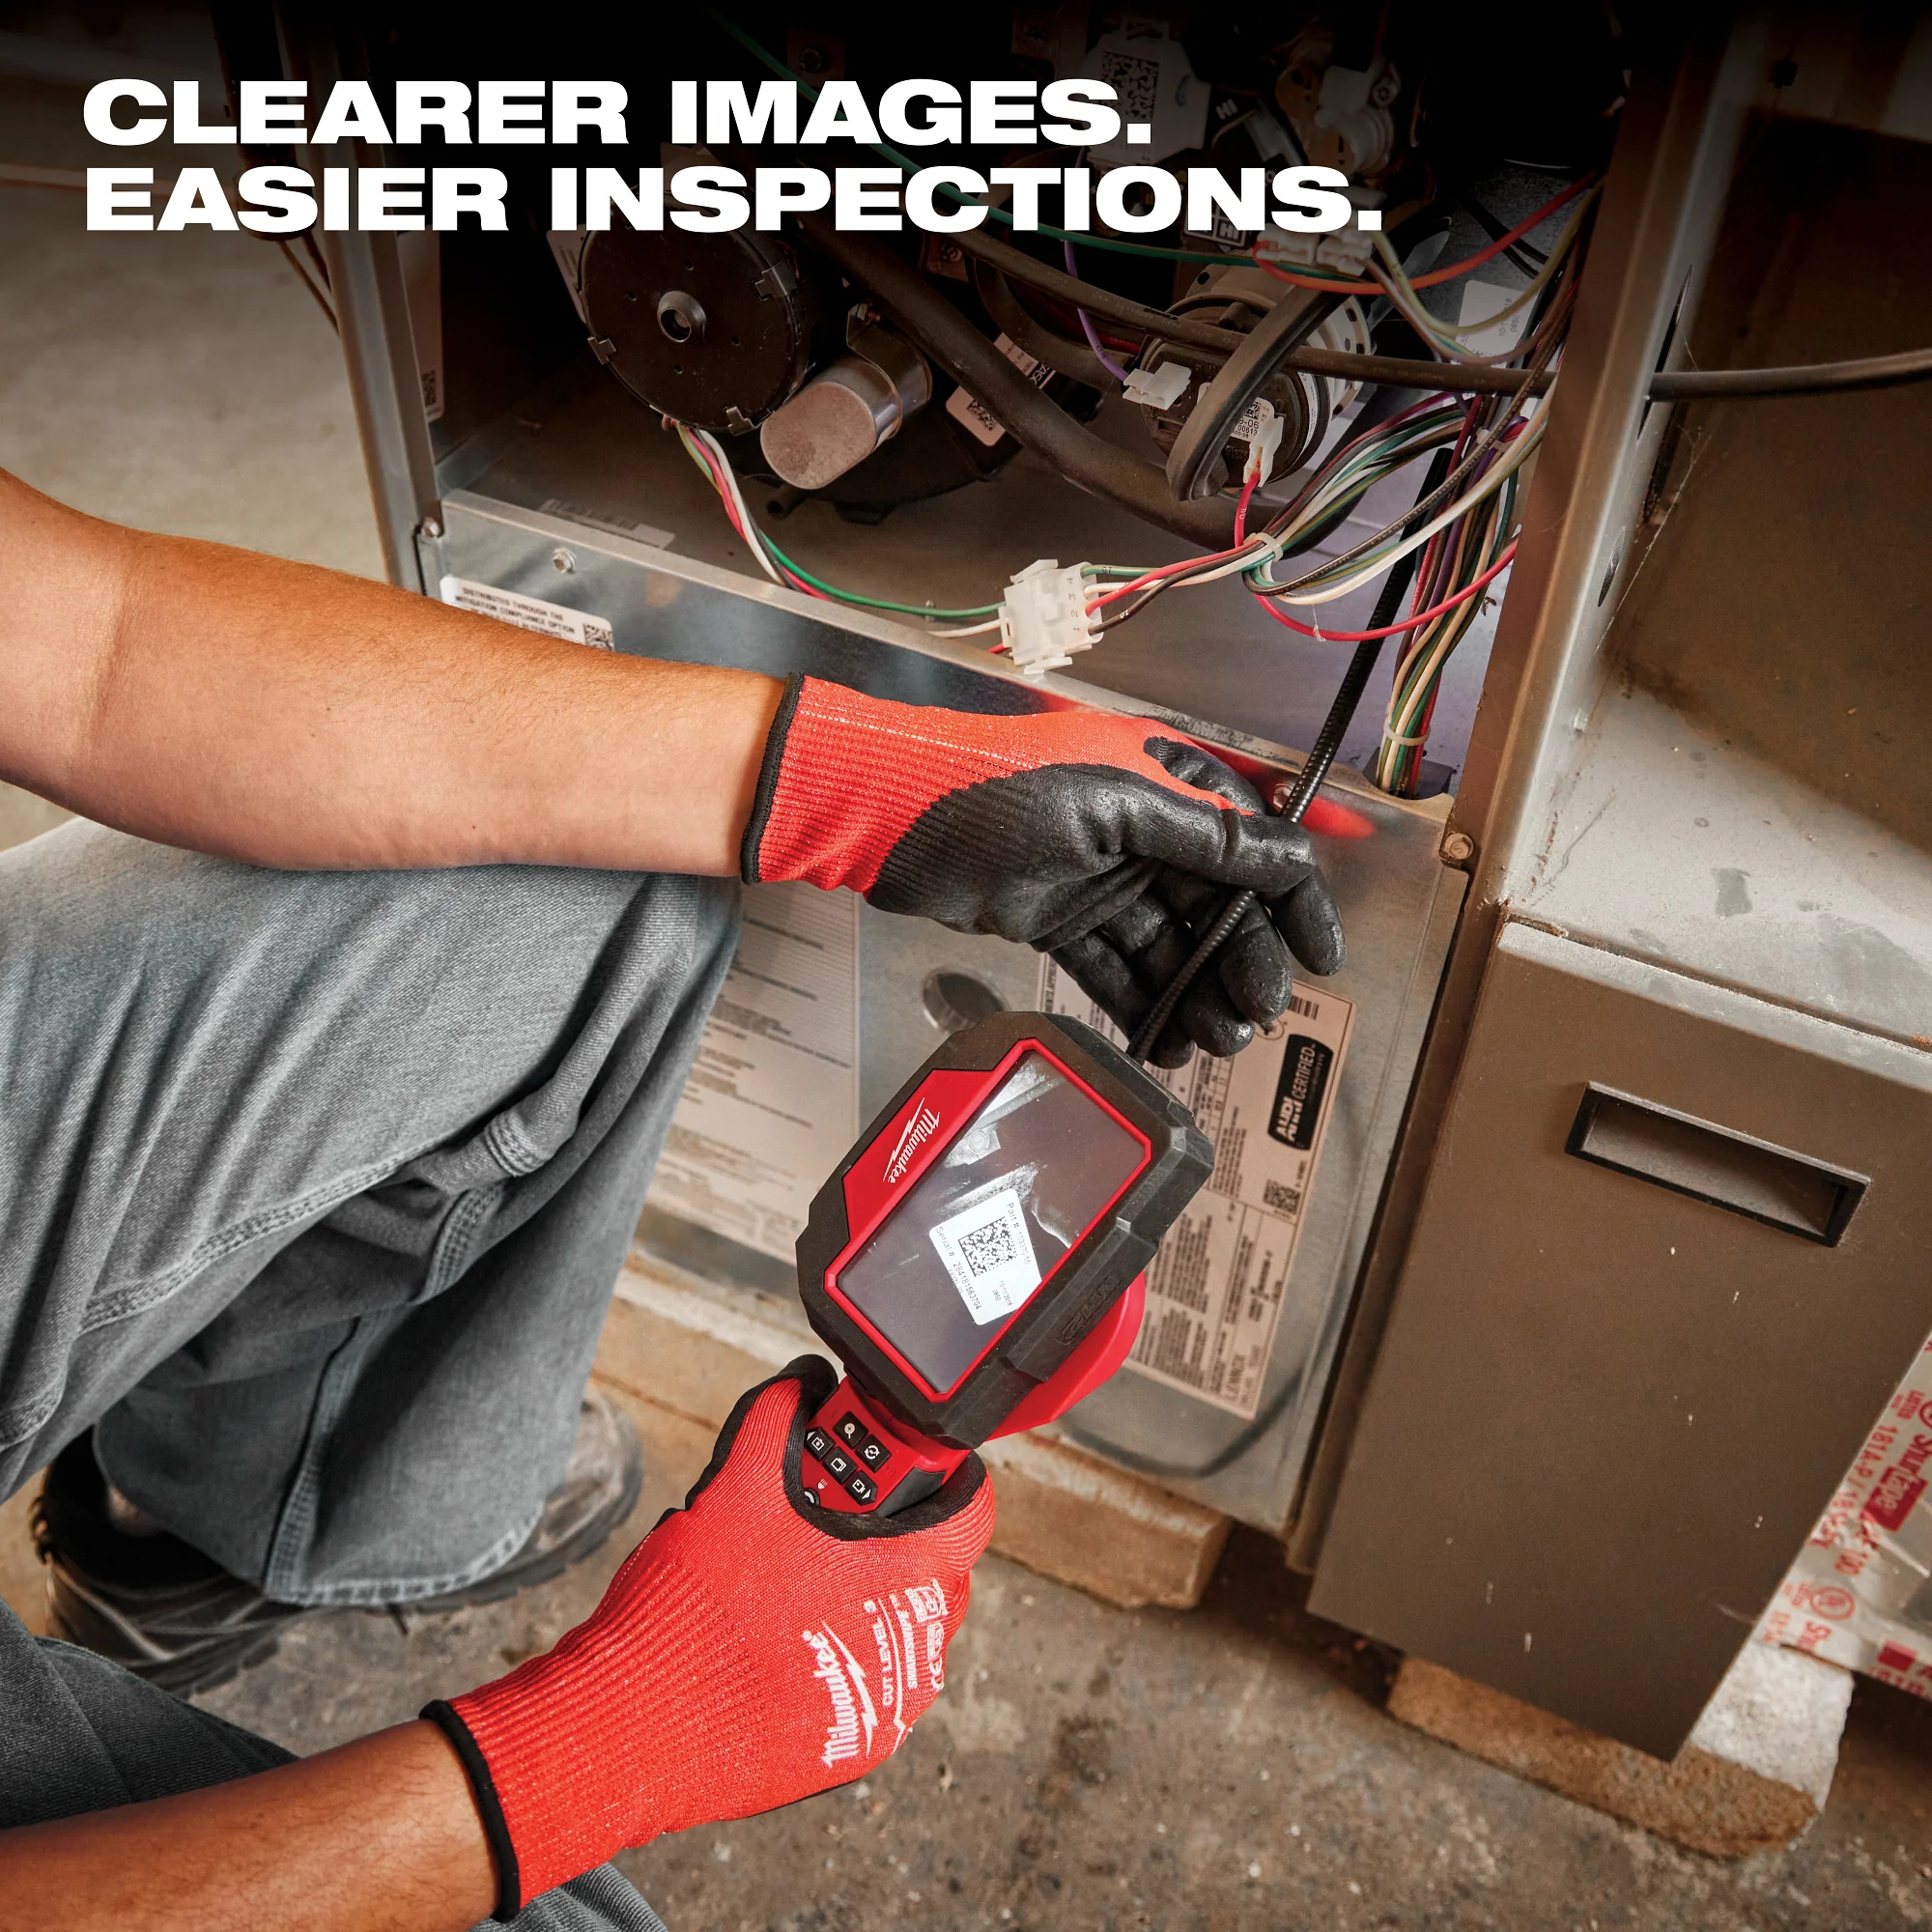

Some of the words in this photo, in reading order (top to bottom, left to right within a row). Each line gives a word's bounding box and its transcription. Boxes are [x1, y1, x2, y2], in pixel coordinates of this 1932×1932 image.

[1290, 1046, 1315, 1099] CERTIFIED
[885, 1108, 940, 1183] Milwaukee
[1008, 1202, 1017, 1222] Part
[935, 1226, 952, 1251] Serial
[873, 1616, 894, 1672] LEVEL
[882, 1676, 895, 1708] CUT
